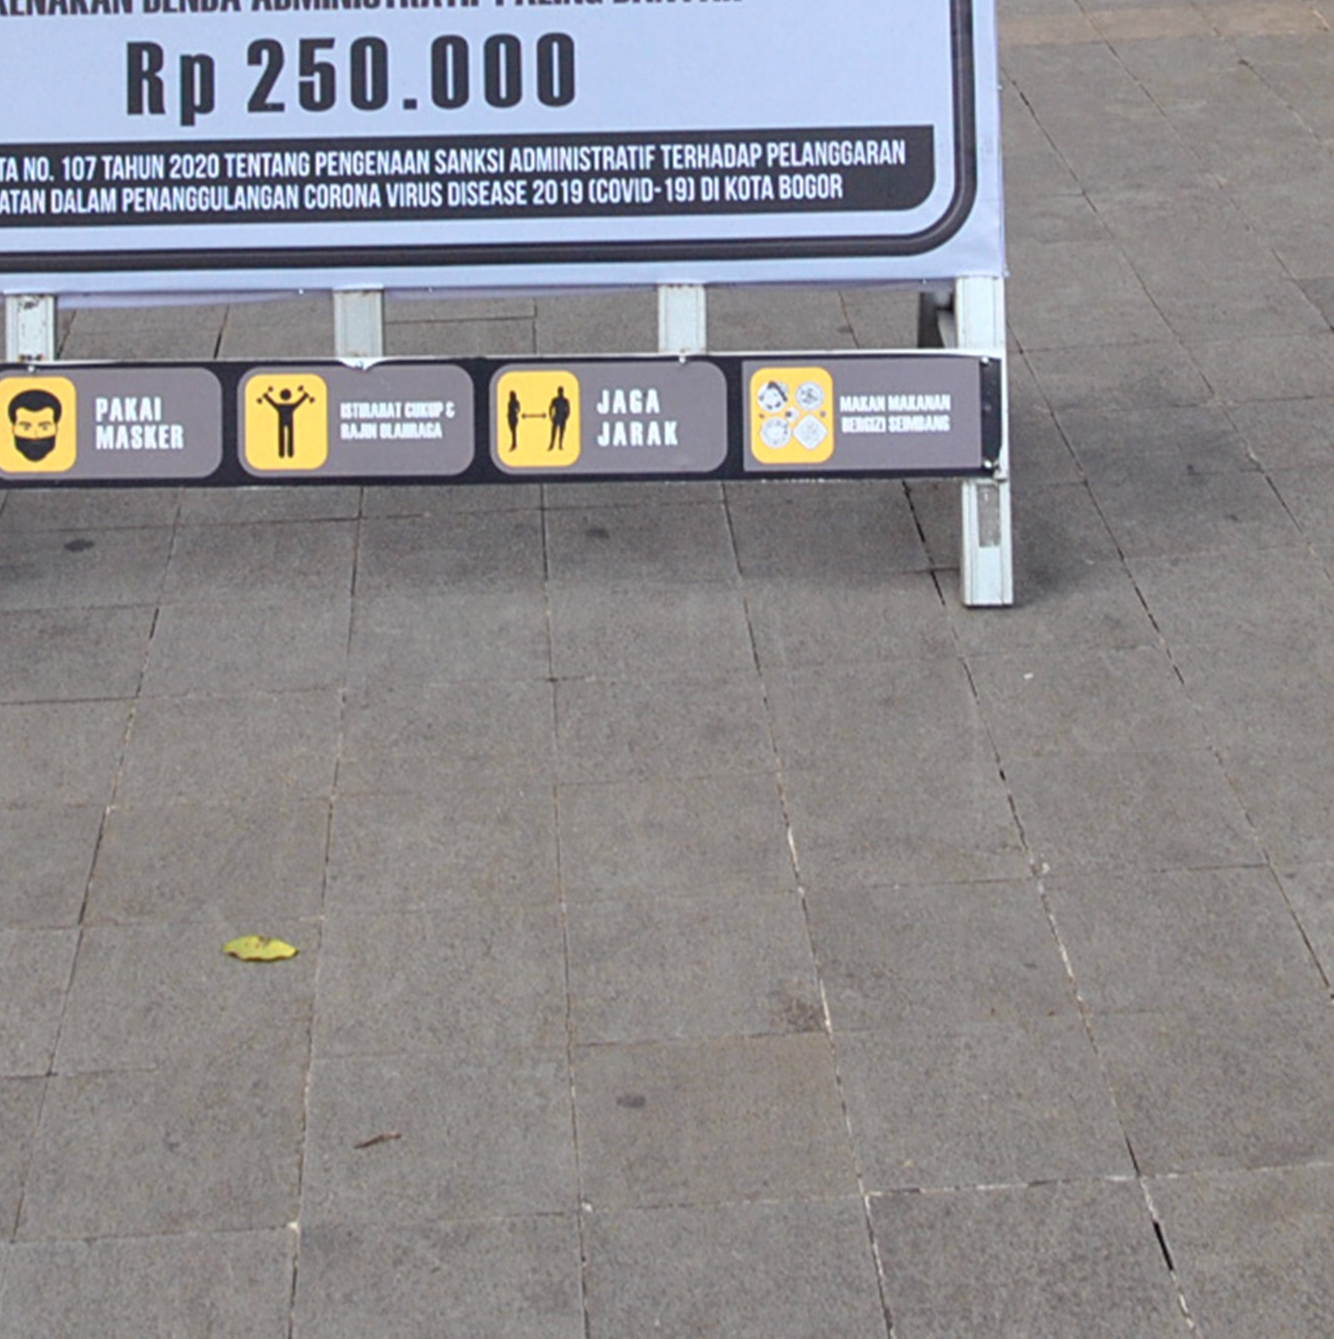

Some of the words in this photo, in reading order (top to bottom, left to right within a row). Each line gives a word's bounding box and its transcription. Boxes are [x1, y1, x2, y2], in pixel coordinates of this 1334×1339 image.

[127, 41, 215, 127] Rp
[247, 33, 575, 113] 250.000
[24, 156, 54, 181] NO.
[62, 156, 97, 181] 107
[101, 155, 164, 180] TAHUN
[170, 153, 219, 179] 2020
[224, 152, 310, 178] TENTANG
[315, 150, 430, 176] PENGENAAN
[435, 148, 504, 174] SANKSI
[510, 145, 655, 172] ADMINISTRATIF
[660, 143, 762, 169] TERHADAP
[767, 140, 905, 167] PELANGGARAN
[51, 188, 116, 213] DALAM
[122, 185, 299, 212] PENANGGULANGAN
[304, 183, 381, 209] CORONA
[386, 182, 442, 207] VIRUS
[448, 180, 527, 206] DISEASE
[533, 179, 583, 204] 2019
[589, 177, 695, 203] (COVID-19)
[701, 176, 719, 201] DI
[725, 175, 774, 200] KOTA
[779, 173, 843, 199] BOGOR
[96, 397, 161, 422] PAKAI
[597, 389, 660, 414] JAGA
[840, 396, 885, 412] MAKAN
[888, 394, 951, 411] MAKANAN
[96, 425, 183, 449] MASKER
[598, 421, 678, 446] JARAK
